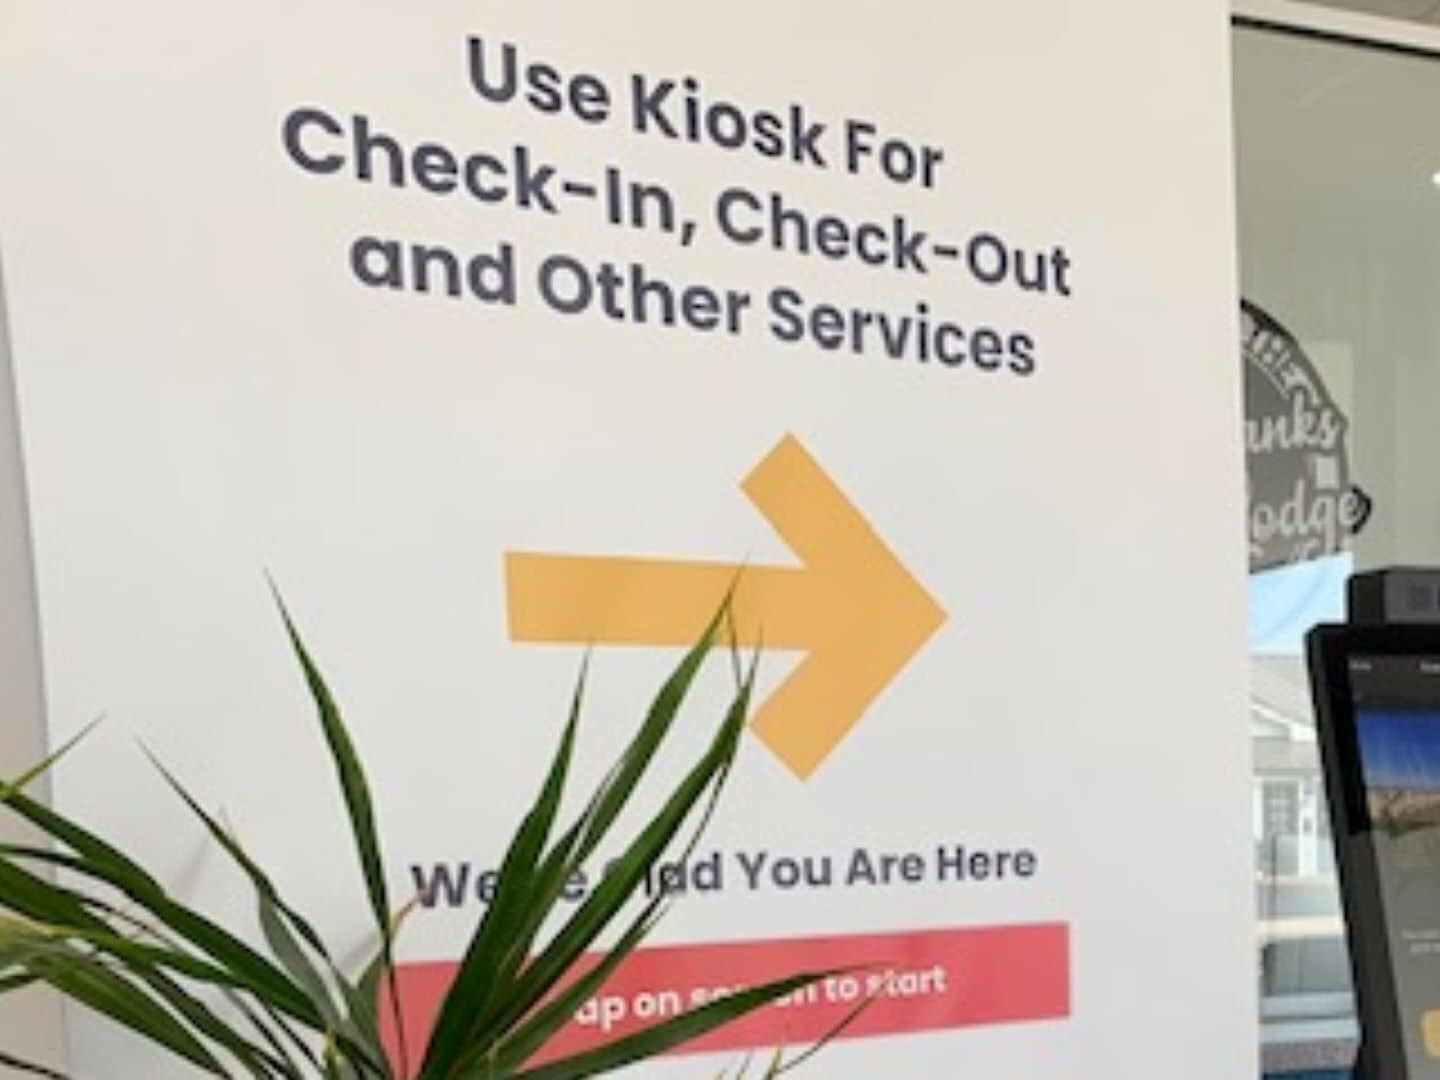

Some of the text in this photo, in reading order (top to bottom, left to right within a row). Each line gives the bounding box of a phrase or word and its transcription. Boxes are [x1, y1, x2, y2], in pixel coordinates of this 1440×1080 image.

[466, 35, 945, 190] Use Kiosk For
[281, 107, 1072, 298] Check-In, Check-Out
[349, 235, 1036, 378] and Other Services
[604, 852, 723, 898] lad
[734, 850, 833, 892] You
[845, 847, 926, 889] Are
[935, 843, 1038, 883] Here
[633, 989, 680, 1018] on
[824, 971, 861, 999] to
[866, 965, 947, 997] start
